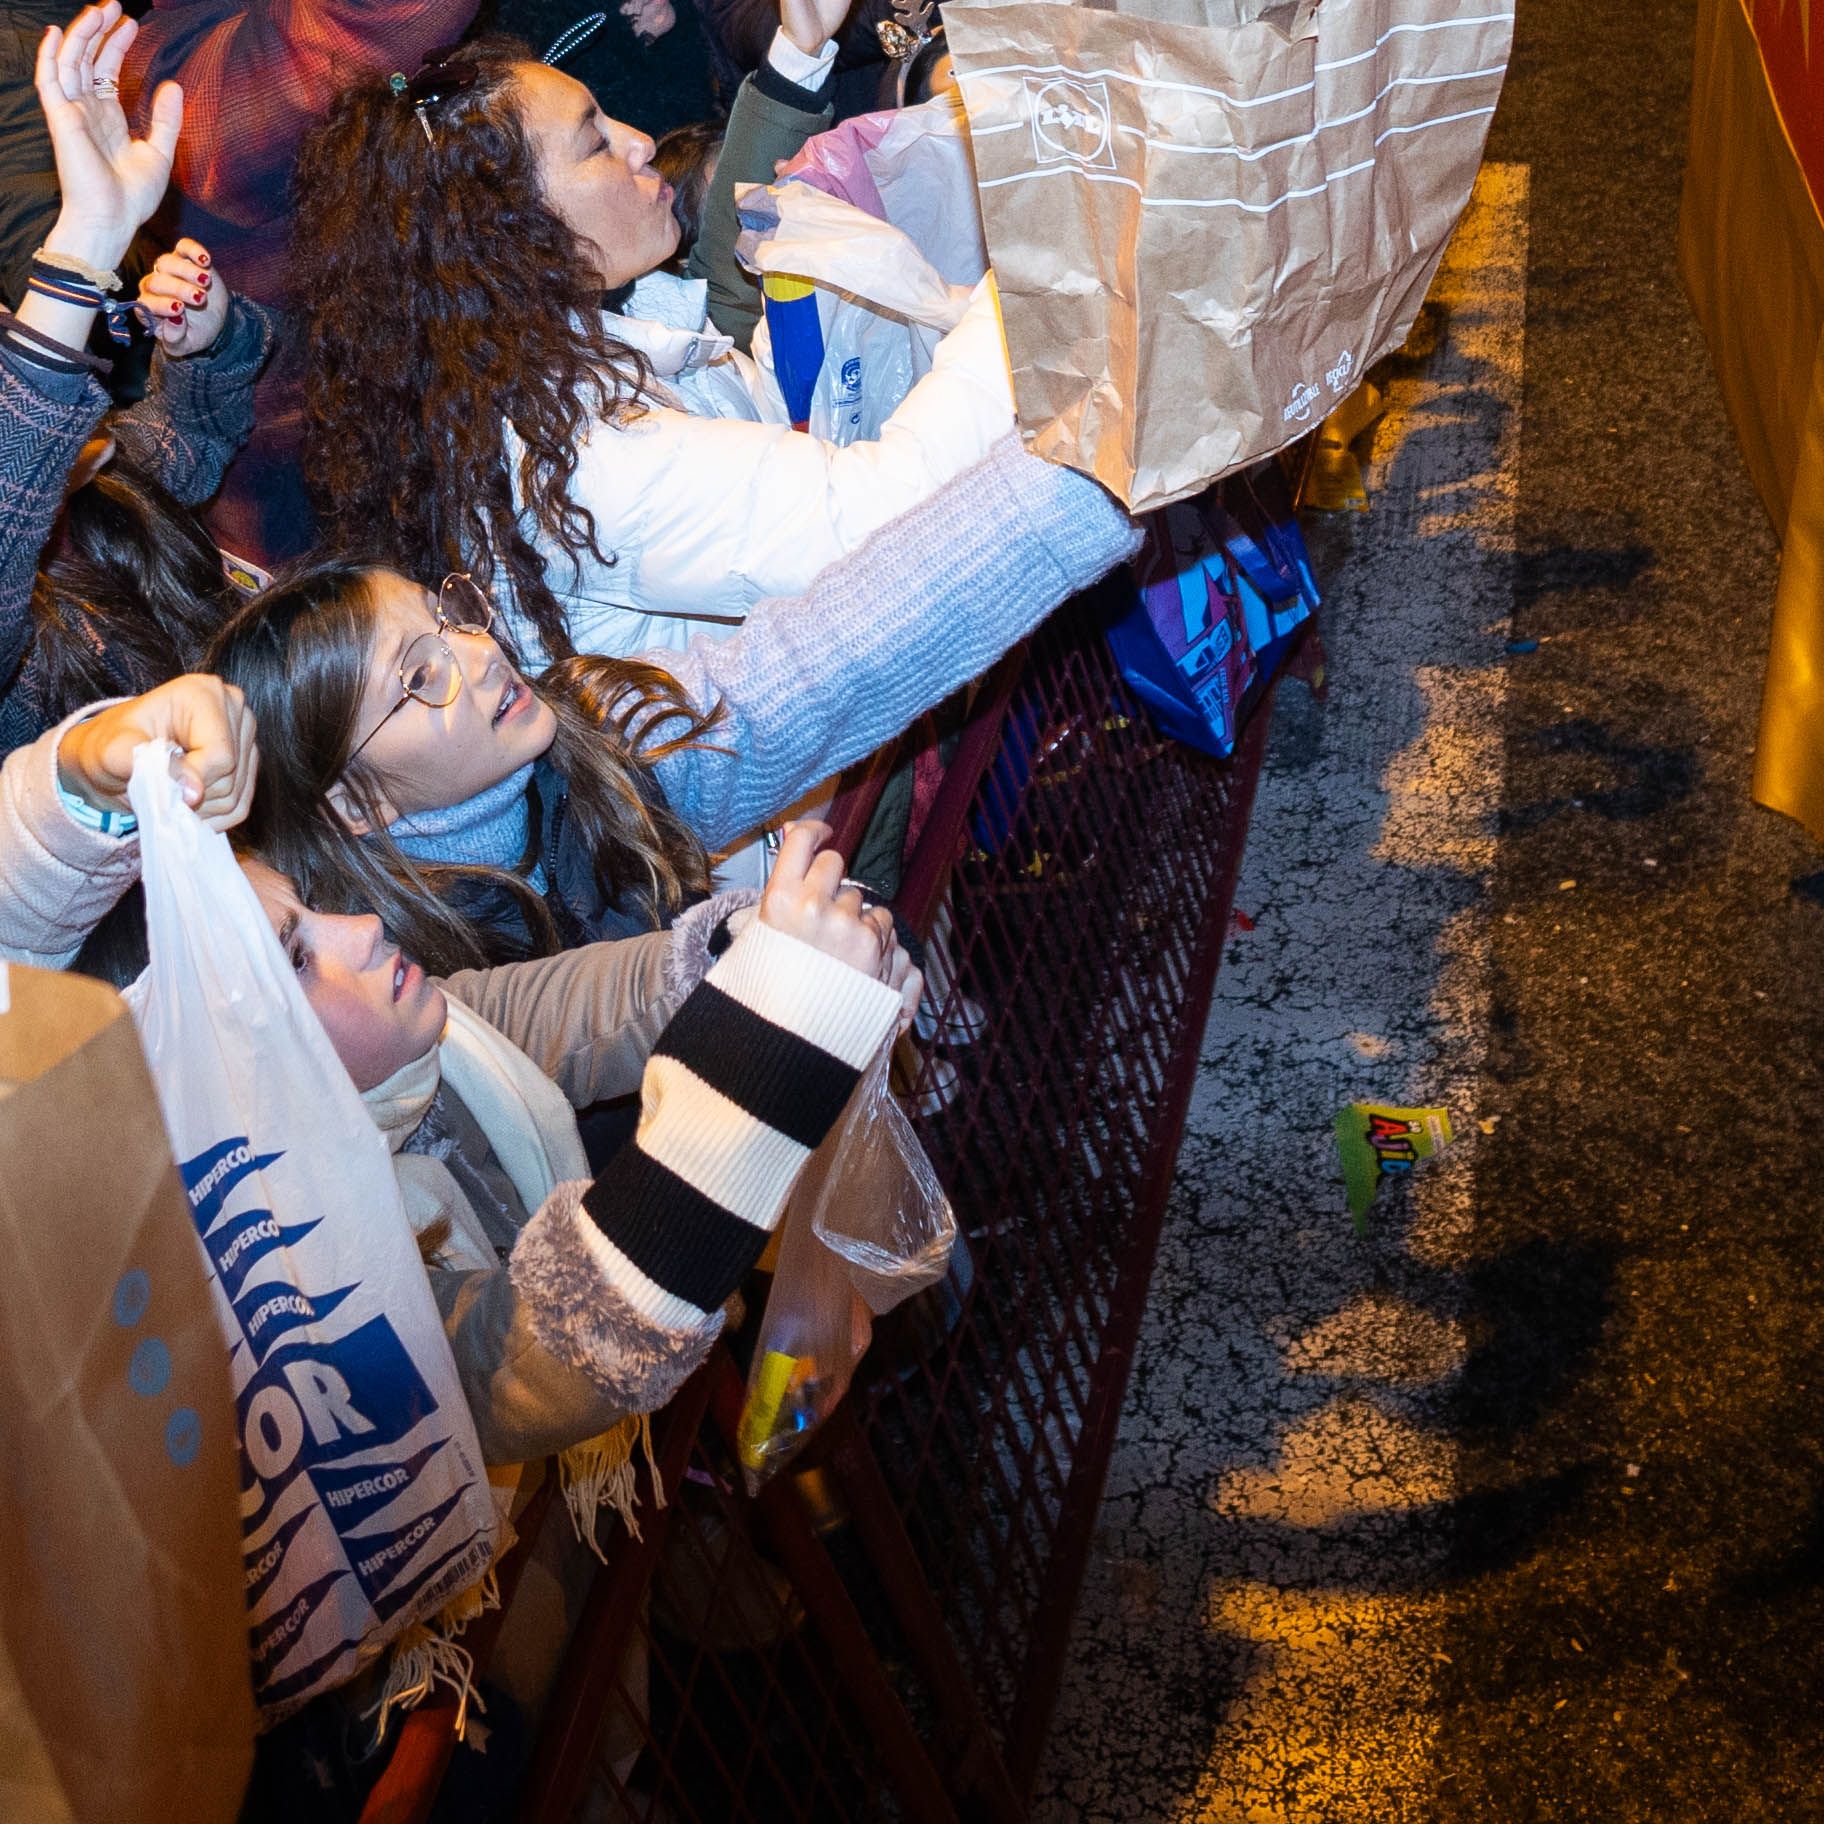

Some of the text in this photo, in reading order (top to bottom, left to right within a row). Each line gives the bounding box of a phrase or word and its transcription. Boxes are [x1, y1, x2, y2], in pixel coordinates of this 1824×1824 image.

[188, 1145, 256, 1207] HIPERCO
[219, 1219, 280, 1274] HIPERCO
[241, 1359, 377, 1519] OR
[326, 1468, 410, 1508] HIPERCOR
[357, 1516, 436, 1576] HIPERCOR
